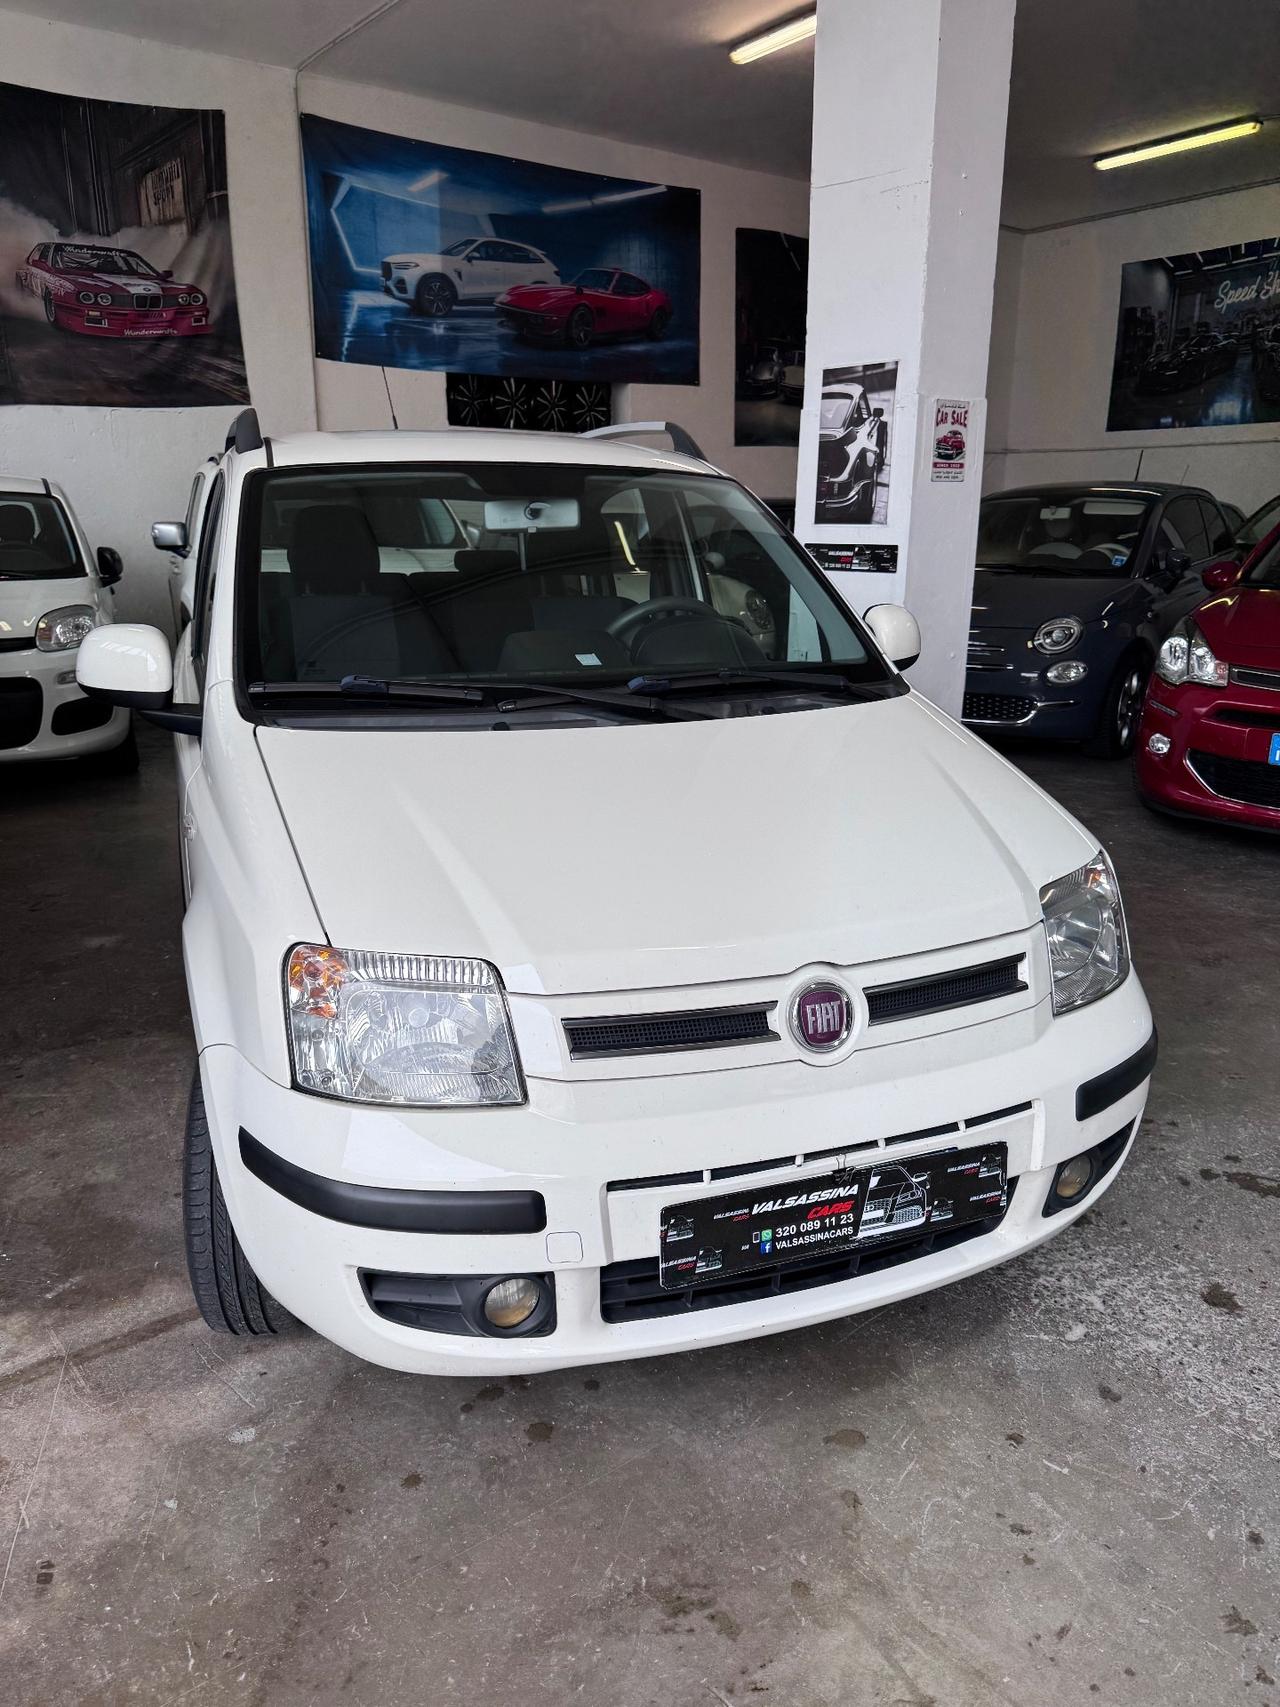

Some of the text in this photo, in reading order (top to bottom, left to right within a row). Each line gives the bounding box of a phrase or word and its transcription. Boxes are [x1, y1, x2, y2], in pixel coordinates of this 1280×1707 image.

[1213, 274, 1262, 315] Speed
[936, 408, 969, 429] CAR SALE
[806, 1000, 841, 1035] FIAT
[751, 1184, 859, 1215] VALSASSINA
[806, 1200, 855, 1219] CARS
[775, 1213, 854, 1237] 320 089 11 23
[775, 1226, 854, 1250] VALSASSINACARS
